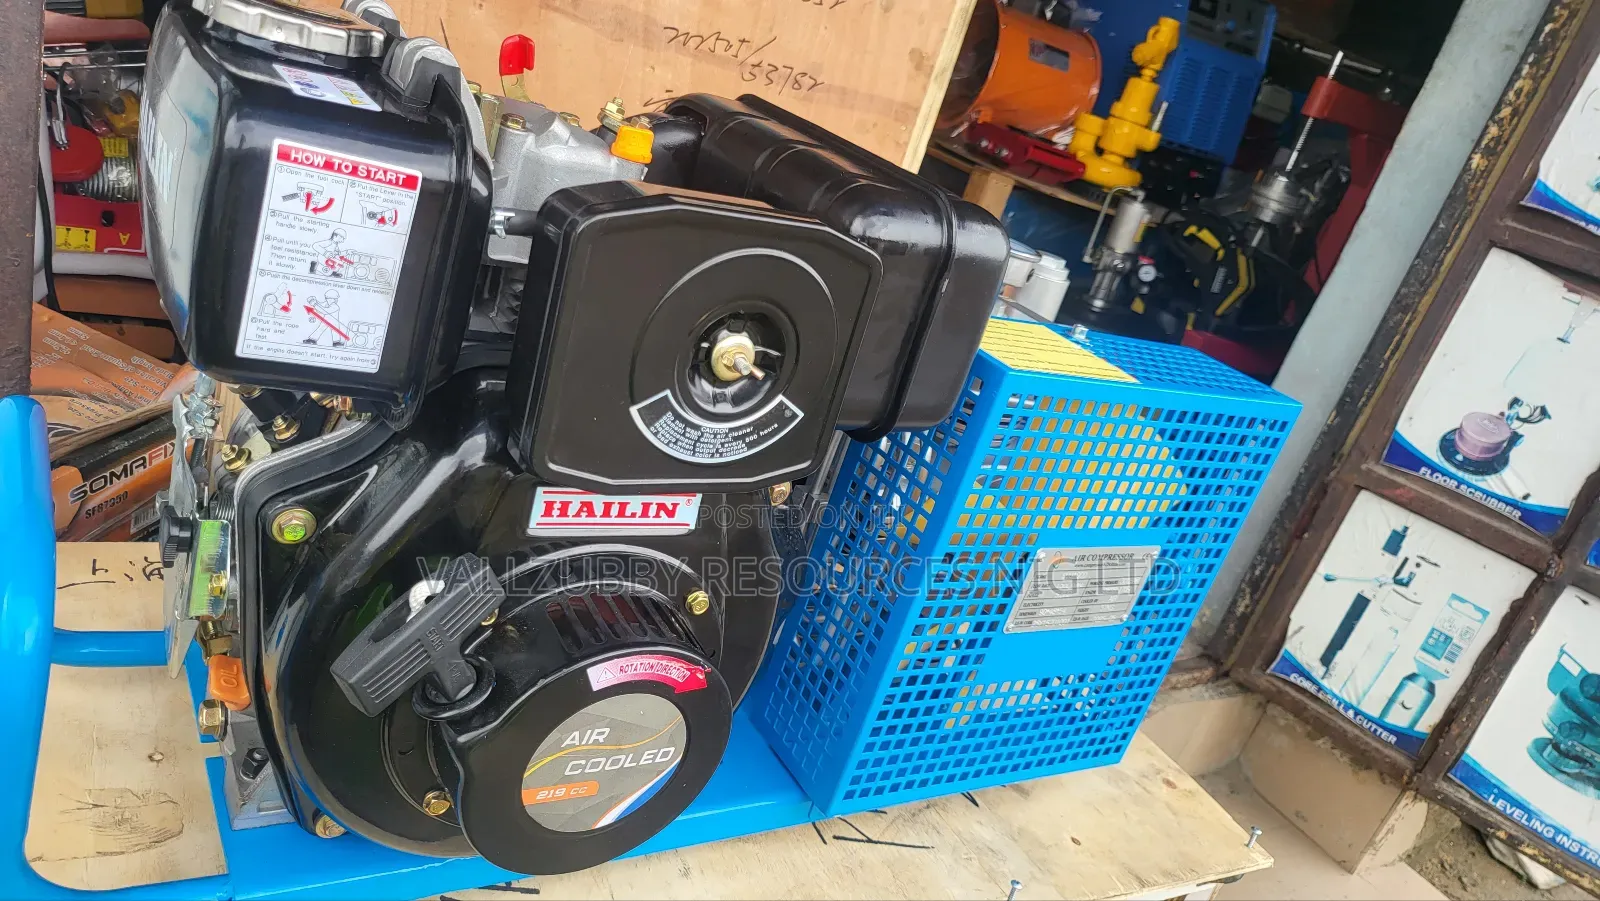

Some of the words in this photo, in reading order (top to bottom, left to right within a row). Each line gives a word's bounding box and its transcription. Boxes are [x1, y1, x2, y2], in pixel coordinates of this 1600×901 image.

[286, 168, 302, 177] Open
[290, 149, 326, 167] HOW
[332, 158, 353, 173] TO
[357, 166, 407, 185] START
[357, 182, 368, 190] Put
[404, 192, 414, 200] the
[276, 221, 296, 230] handle
[277, 212, 290, 220] Pull
[294, 215, 304, 223] the
[306, 219, 330, 229] starting
[286, 239, 299, 247] until
[300, 241, 311, 250] you
[270, 252, 286, 260] Then
[287, 255, 307, 263] return
[267, 347, 285, 355] engine
[287, 348, 309, 356] doesn't
[340, 355, 355, 363] again
[123, 375, 139, 387] Size
[139, 383, 159, 397] Hose
[665, 411, 673, 421] Do
[675, 418, 686, 429] not
[659, 420, 695, 445] Replacement
[724, 439, 743, 448] every
[759, 423, 779, 436] hours
[677, 440, 694, 451] when
[1419, 466, 1458, 491] FLOOR
[1460, 483, 1523, 521] SCRUBBER
[540, 500, 680, 519] HAILIN
[1074, 554, 1086, 562] AIR
[1087, 553, 1134, 562] COMPRESSOR
[221, 662, 238, 689] OIL
[619, 662, 655, 675] ROTATION
[656, 662, 689, 682] DIRECTION
[1289, 672, 1319, 694] CORE
[1355, 714, 1398, 745] CUTTER
[561, 727, 611, 748] AIR
[564, 746, 676, 776] COOLED
[535, 787, 567, 800] 219
[1488, 794, 1555, 838] LEVELING
